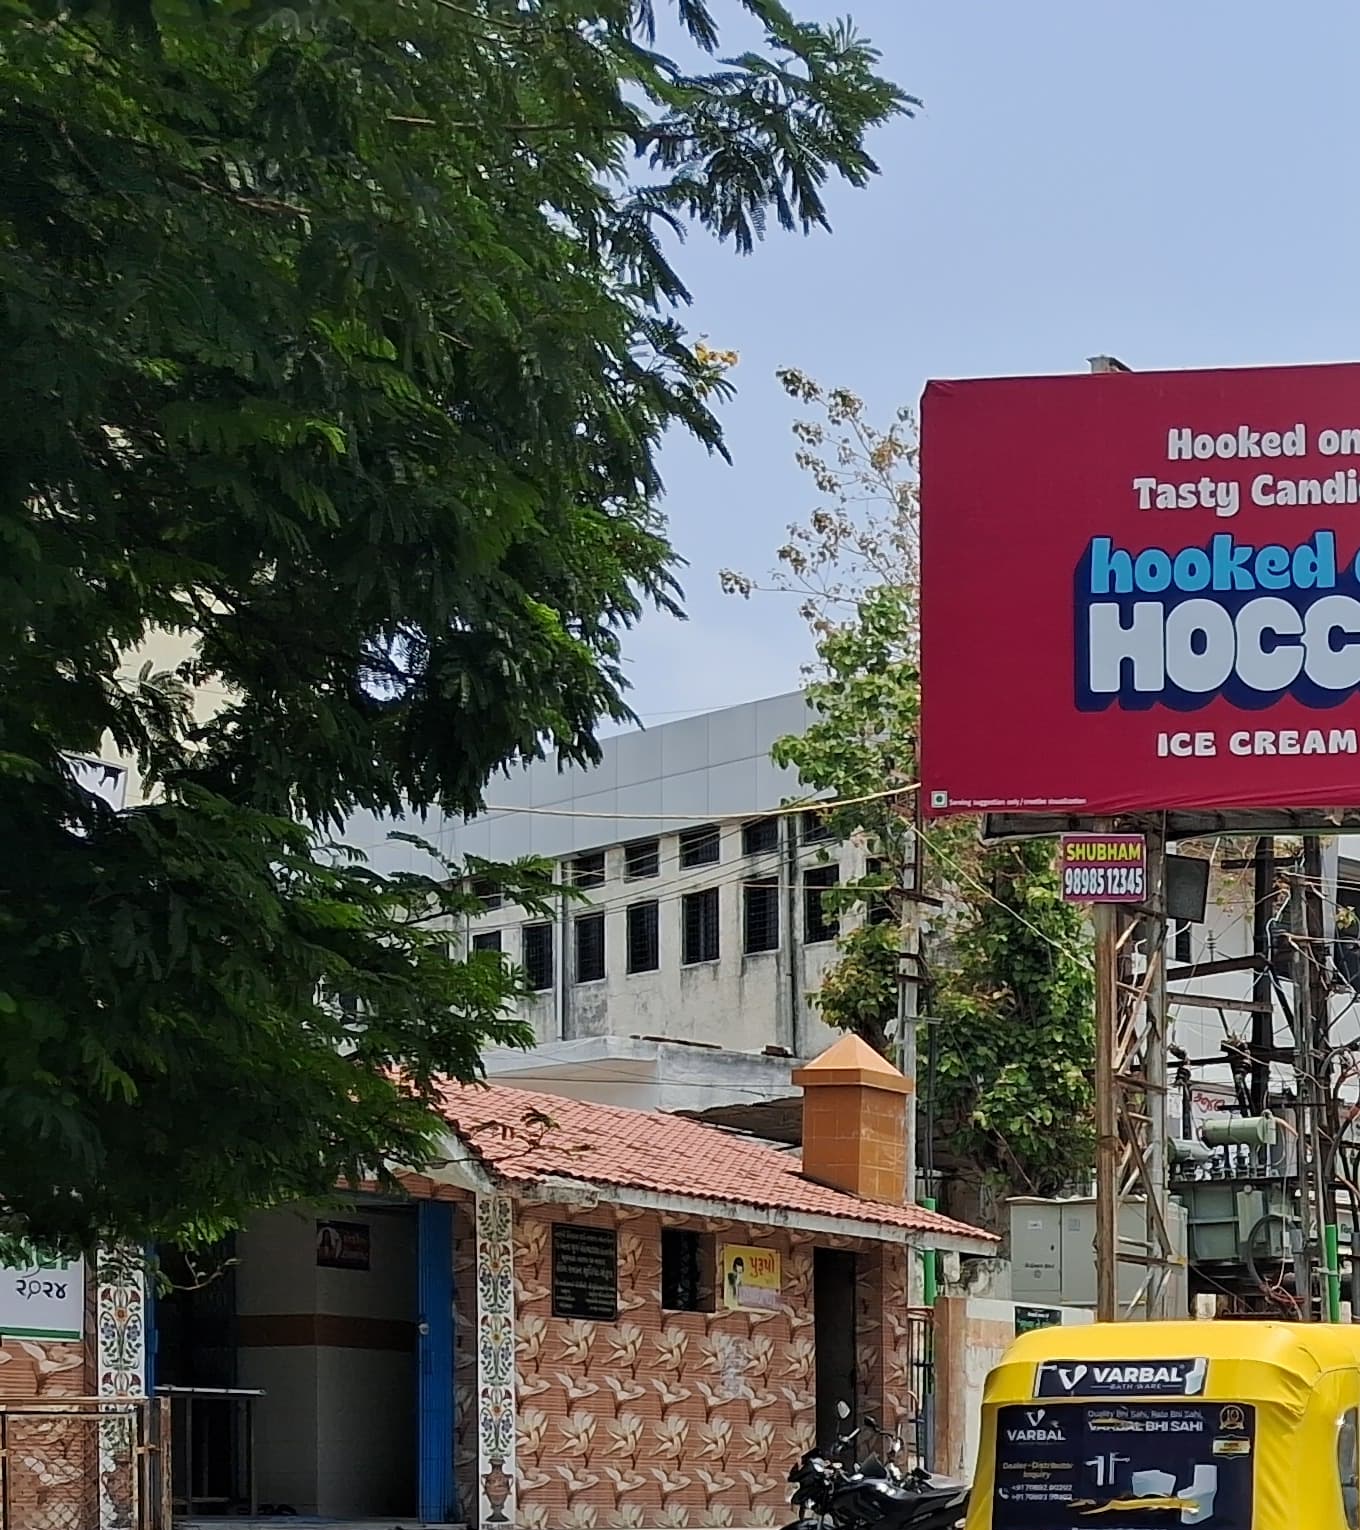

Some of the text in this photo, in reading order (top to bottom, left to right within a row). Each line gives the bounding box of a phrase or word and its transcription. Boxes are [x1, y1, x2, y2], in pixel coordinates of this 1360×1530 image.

[1168, 424, 1306, 460] Hooked
[1134, 476, 1240, 517] Tasty
[1090, 531, 1337, 594] hooked
[1157, 729, 1358, 757] ICE CREAM
[1066, 843, 1141, 861] SHUBHAM
[1065, 867, 1143, 895] 98985 12345
[1093, 1367, 1183, 1383] VARBAL
[1006, 1430, 1067, 1441] VARBAL
[1145, 1421, 1169, 1432] BHI
[1170, 1421, 1204, 1432] SAHI
